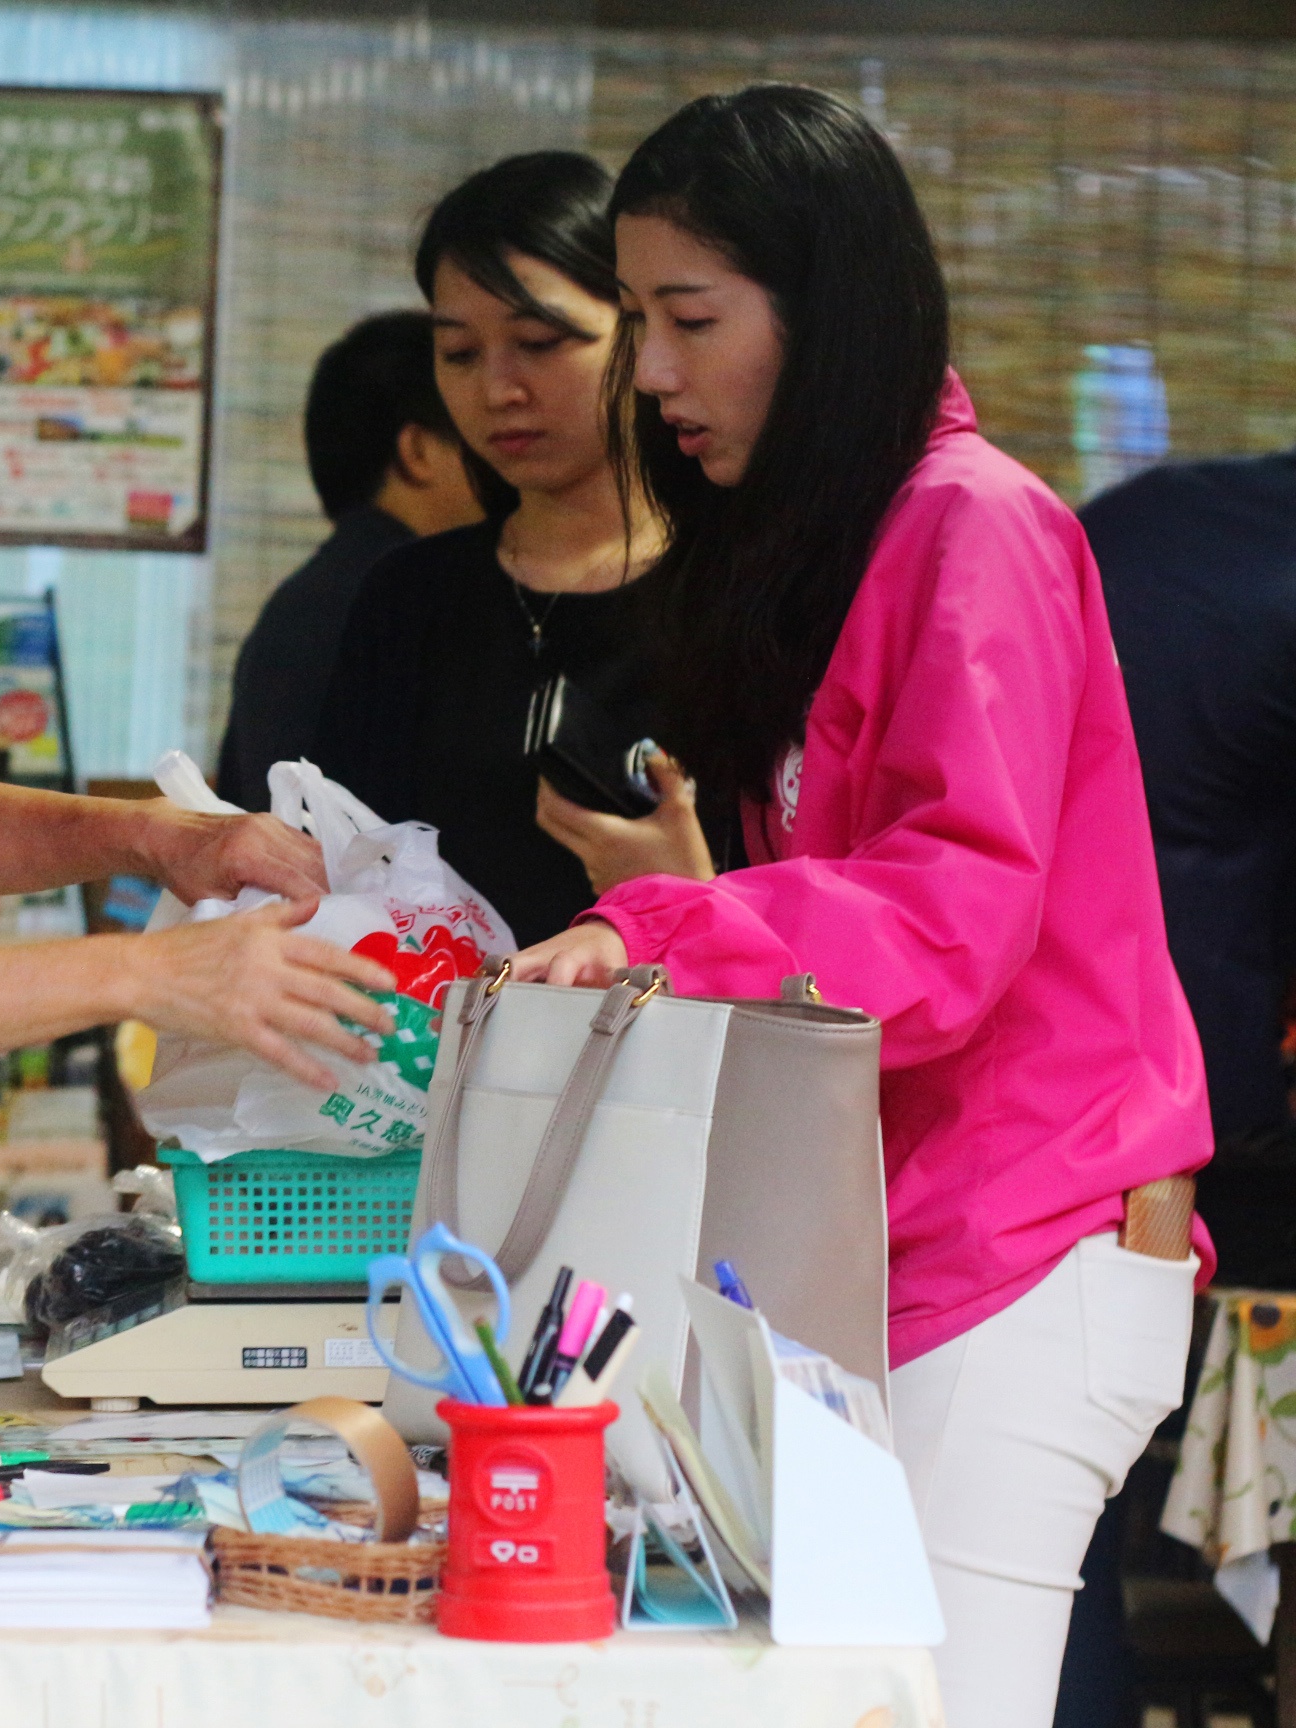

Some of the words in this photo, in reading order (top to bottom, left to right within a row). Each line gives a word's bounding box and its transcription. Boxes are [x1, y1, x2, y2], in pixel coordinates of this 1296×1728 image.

[319, 1092, 426, 1145] 奥久慈
[490, 1494, 537, 1511] POST
